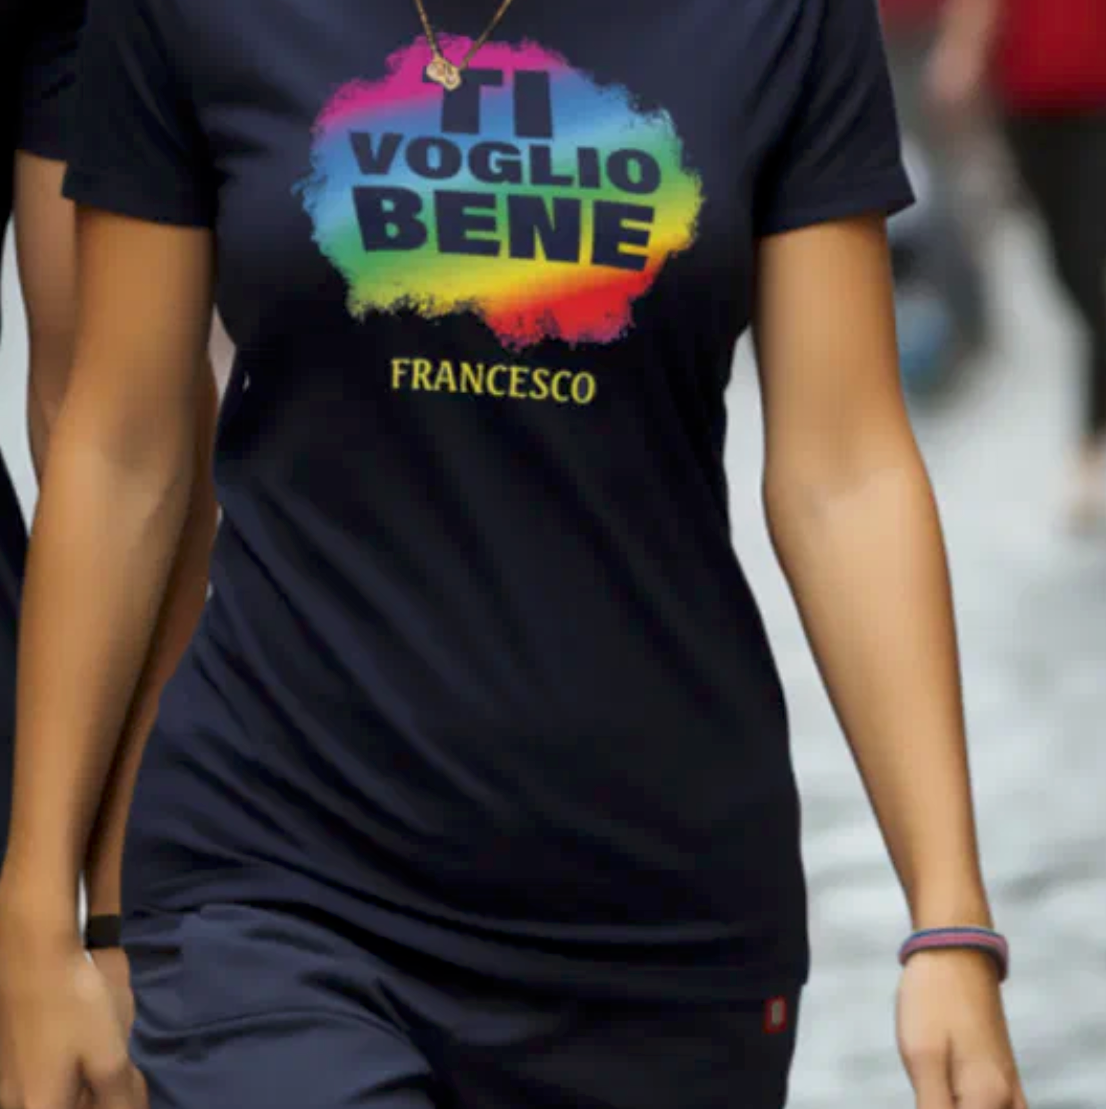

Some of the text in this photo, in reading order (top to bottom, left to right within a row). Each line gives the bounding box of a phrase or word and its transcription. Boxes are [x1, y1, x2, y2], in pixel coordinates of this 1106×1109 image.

[422, 68, 554, 139] TI
[349, 132, 661, 194] VOGLIO
[352, 185, 655, 270] BENE
[391, 358, 595, 403] FRANCESCO
